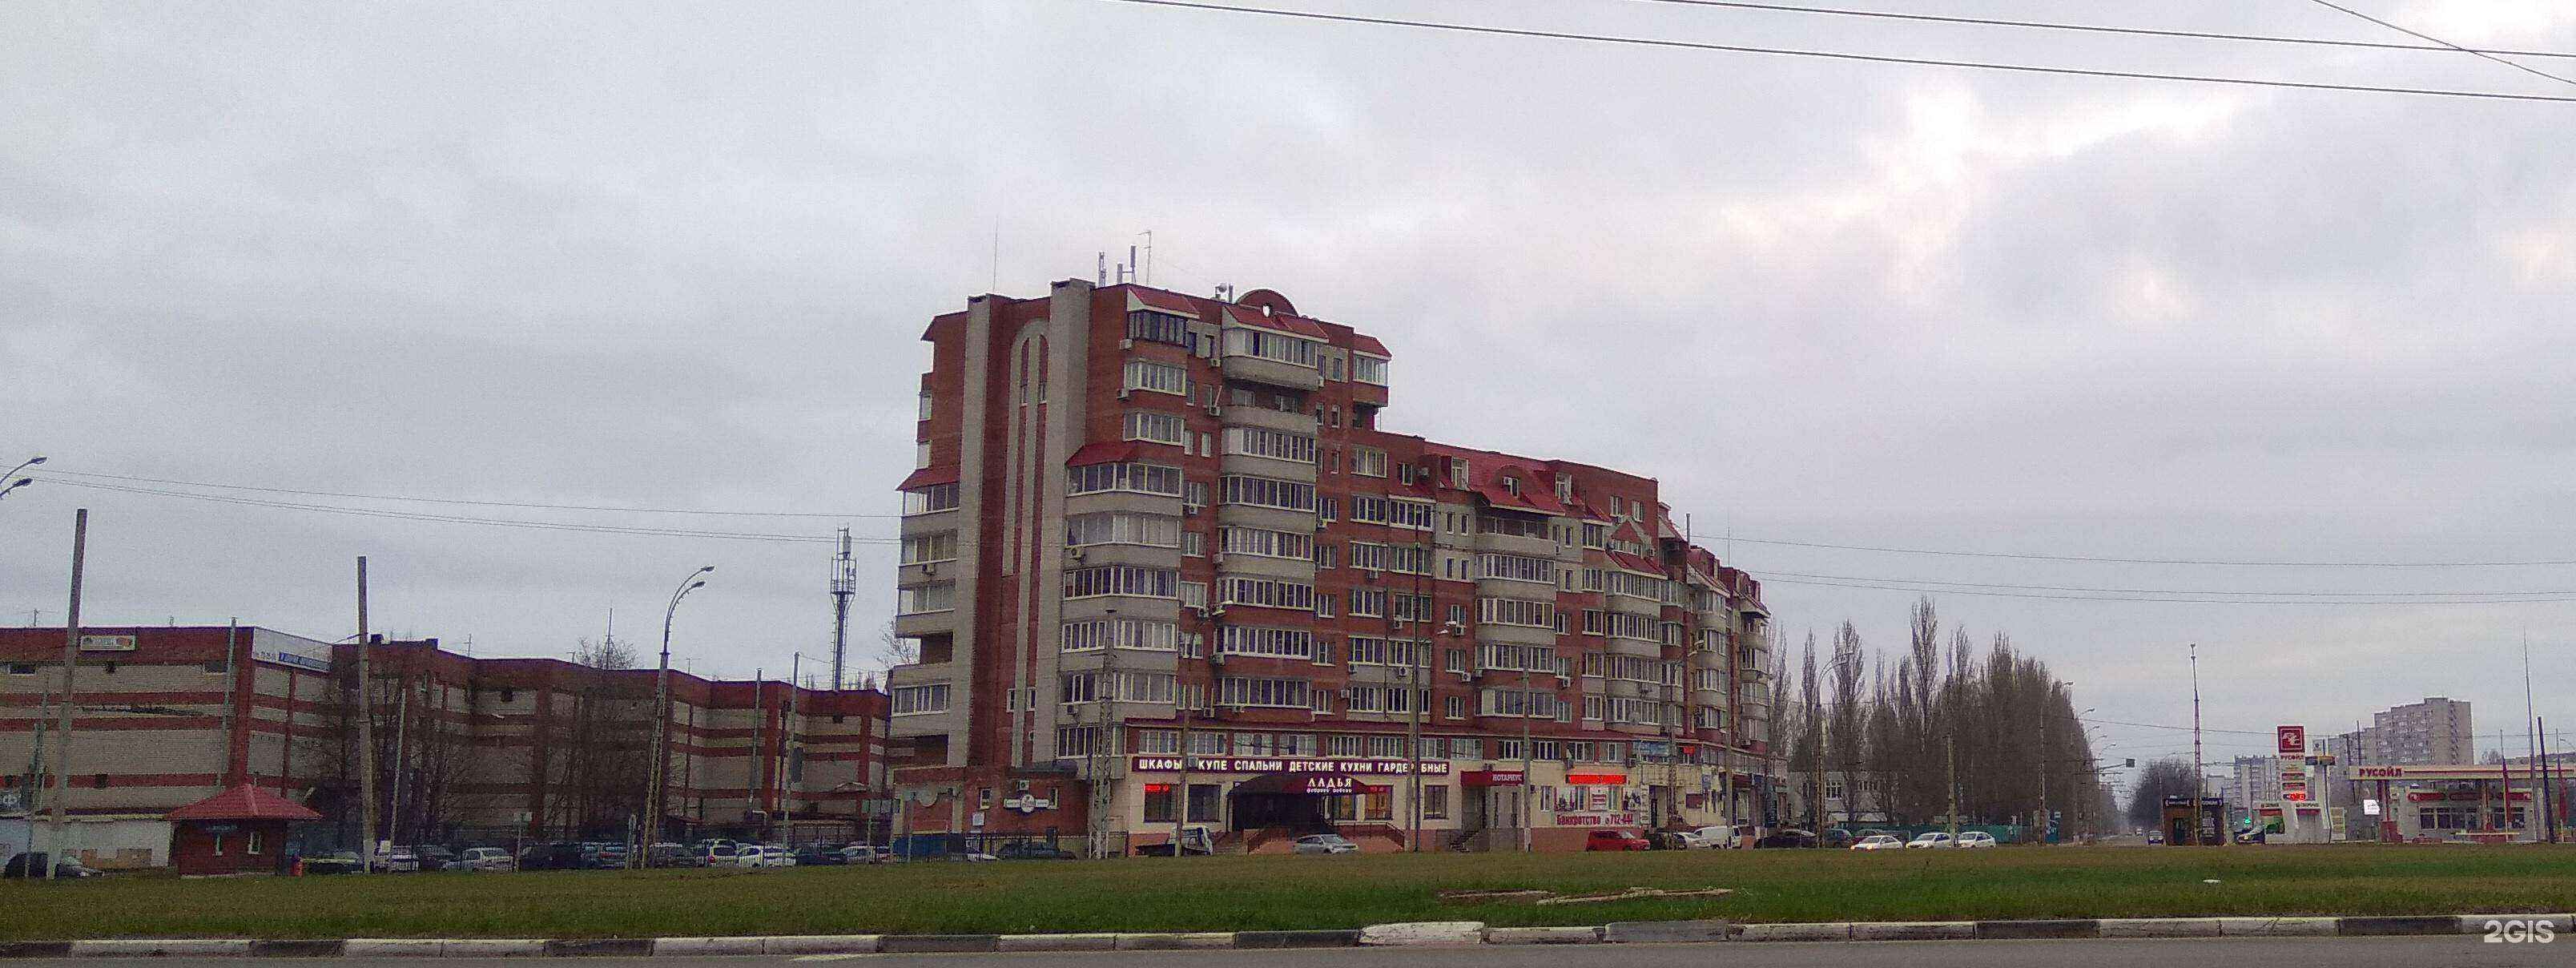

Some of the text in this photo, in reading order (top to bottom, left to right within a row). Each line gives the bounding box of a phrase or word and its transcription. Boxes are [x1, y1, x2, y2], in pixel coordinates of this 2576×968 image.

[1139, 759, 1181, 769] ШКАФЫ
[1198, 760, 1227, 770] КУПЕ
[1234, 760, 1282, 770] СПАЛЬНИ
[1289, 761, 1334, 772] ДЕТСКИЕ
[1340, 762, 1372, 772] КУХНИ
[2359, 766, 2402, 776] РУСОЙЛ
[1307, 778, 1352, 788] ЛАДЬЯ
